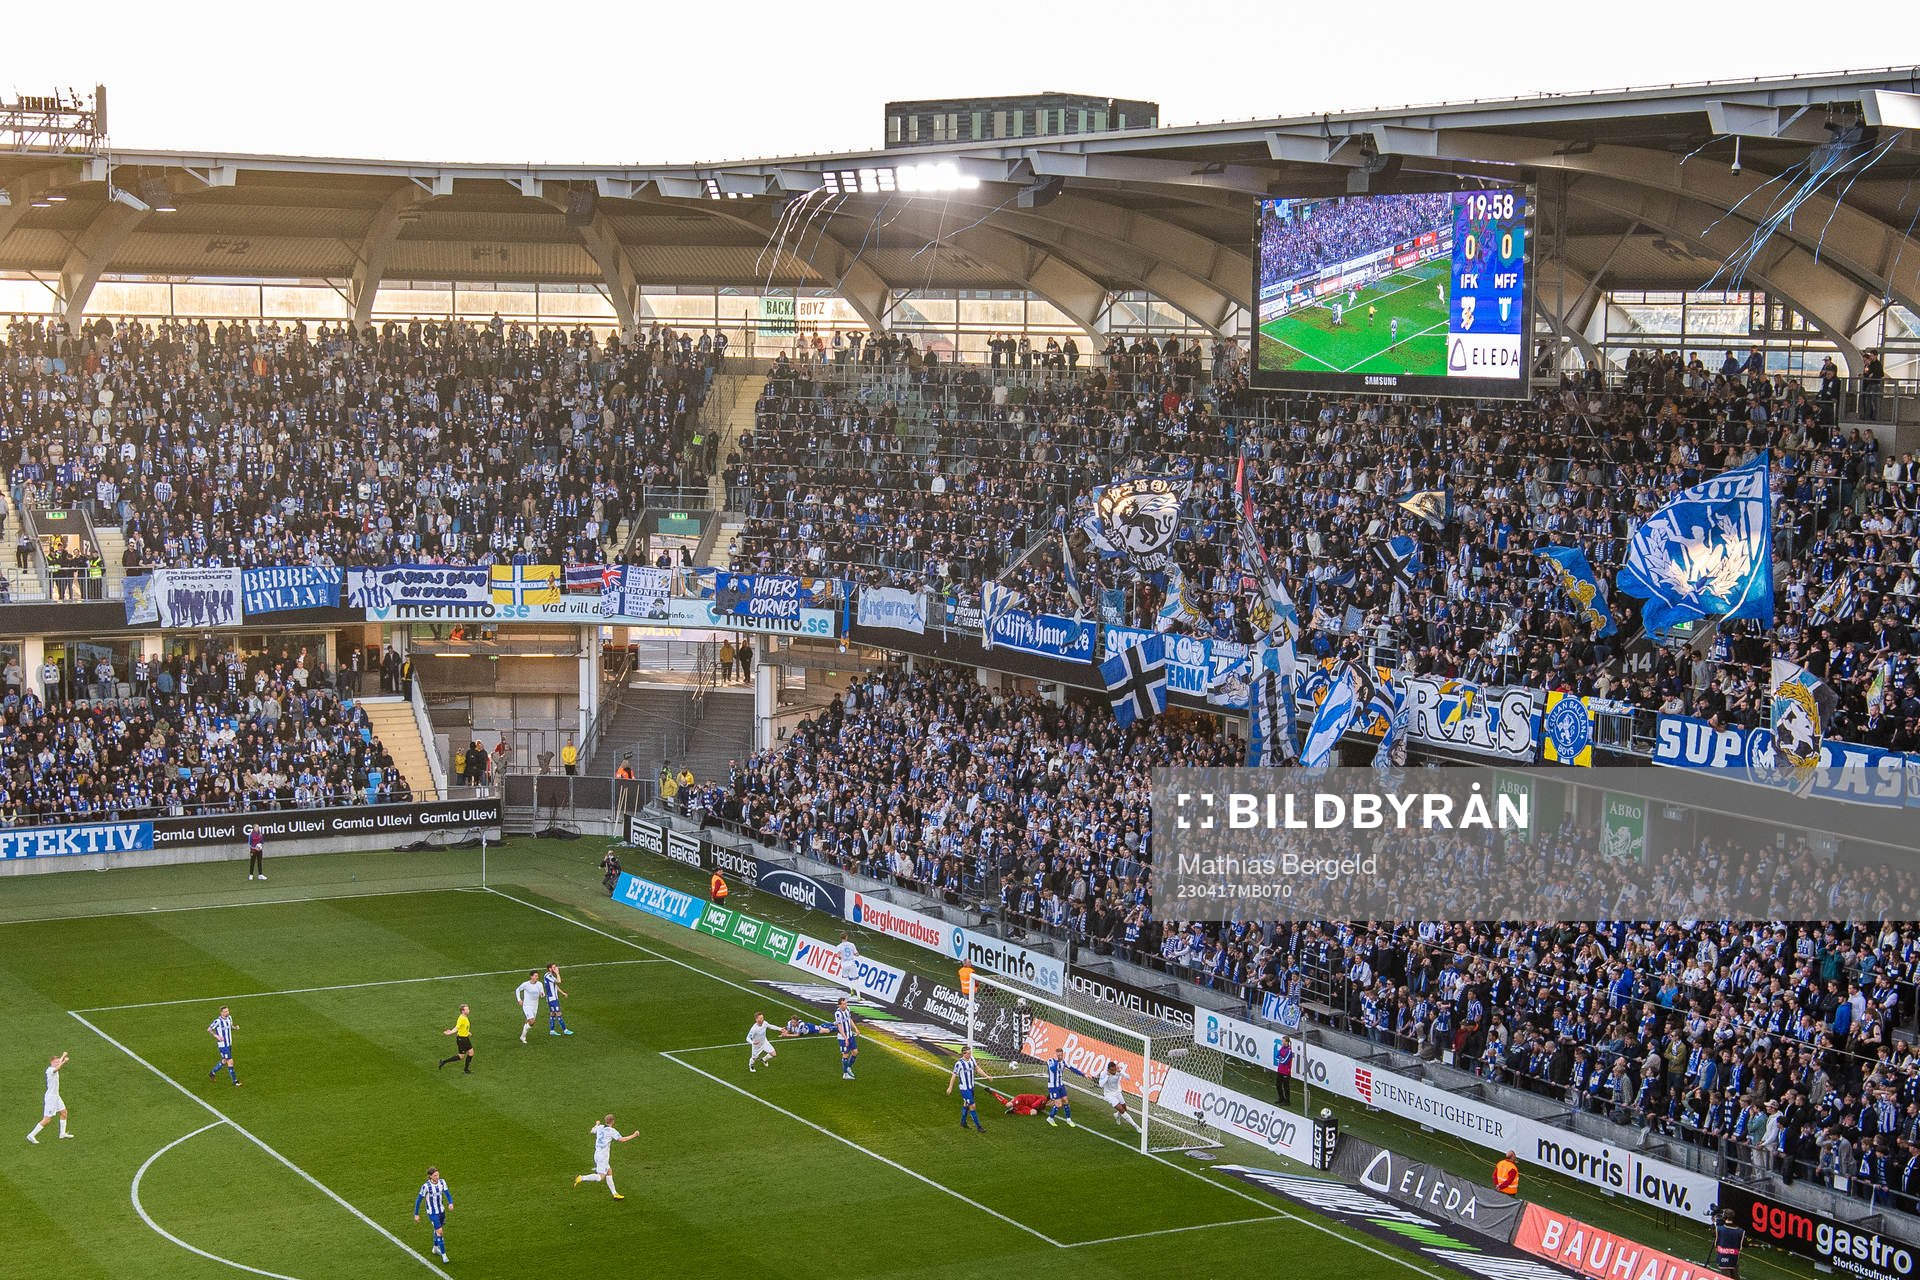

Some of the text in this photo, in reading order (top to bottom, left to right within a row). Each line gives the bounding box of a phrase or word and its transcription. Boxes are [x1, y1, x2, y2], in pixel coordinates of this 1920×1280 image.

[1467, 194, 1513, 220] 19:58
[1465, 235, 1475, 260] 0
[1501, 233, 1512, 260] 0
[1461, 273, 1517, 289] IFK MFF
[800, 301, 824, 316] BOYZ
[1473, 348, 1518, 366] ELEDA
[1365, 375, 1397, 386] SAMSUNG
[243, 567, 341, 592] BEBBENS
[753, 576, 799, 598] HATERS
[614, 586, 669, 598] LONDONERS
[749, 597, 799, 617] CORNER
[955, 607, 980, 618] BROWN
[1557, 744, 1575, 755] BOYS
[288, 819, 325, 834] Ullevi
[332, 814, 412, 831] Gamla Ullevi
[419, 808, 497, 825] Gamla Ullevi
[153, 825, 235, 842] Gamla Ullevi
[711, 843, 757, 879] Helanders
[625, 877, 692, 917] EFFEKTIV
[780, 881, 816, 907] cuebid
[707, 909, 788, 950] MCR MCR MCR
[863, 903, 940, 947] Bergkvarabuss
[967, 939, 1059, 993] merinfo.se
[1262, 991, 1285, 1022] IFK
[1374, 1079, 1504, 1139] STENFASTIGHETER
[1313, 1124, 1322, 1169] SELECT
[1400, 1170, 1478, 1220] ELEDA
